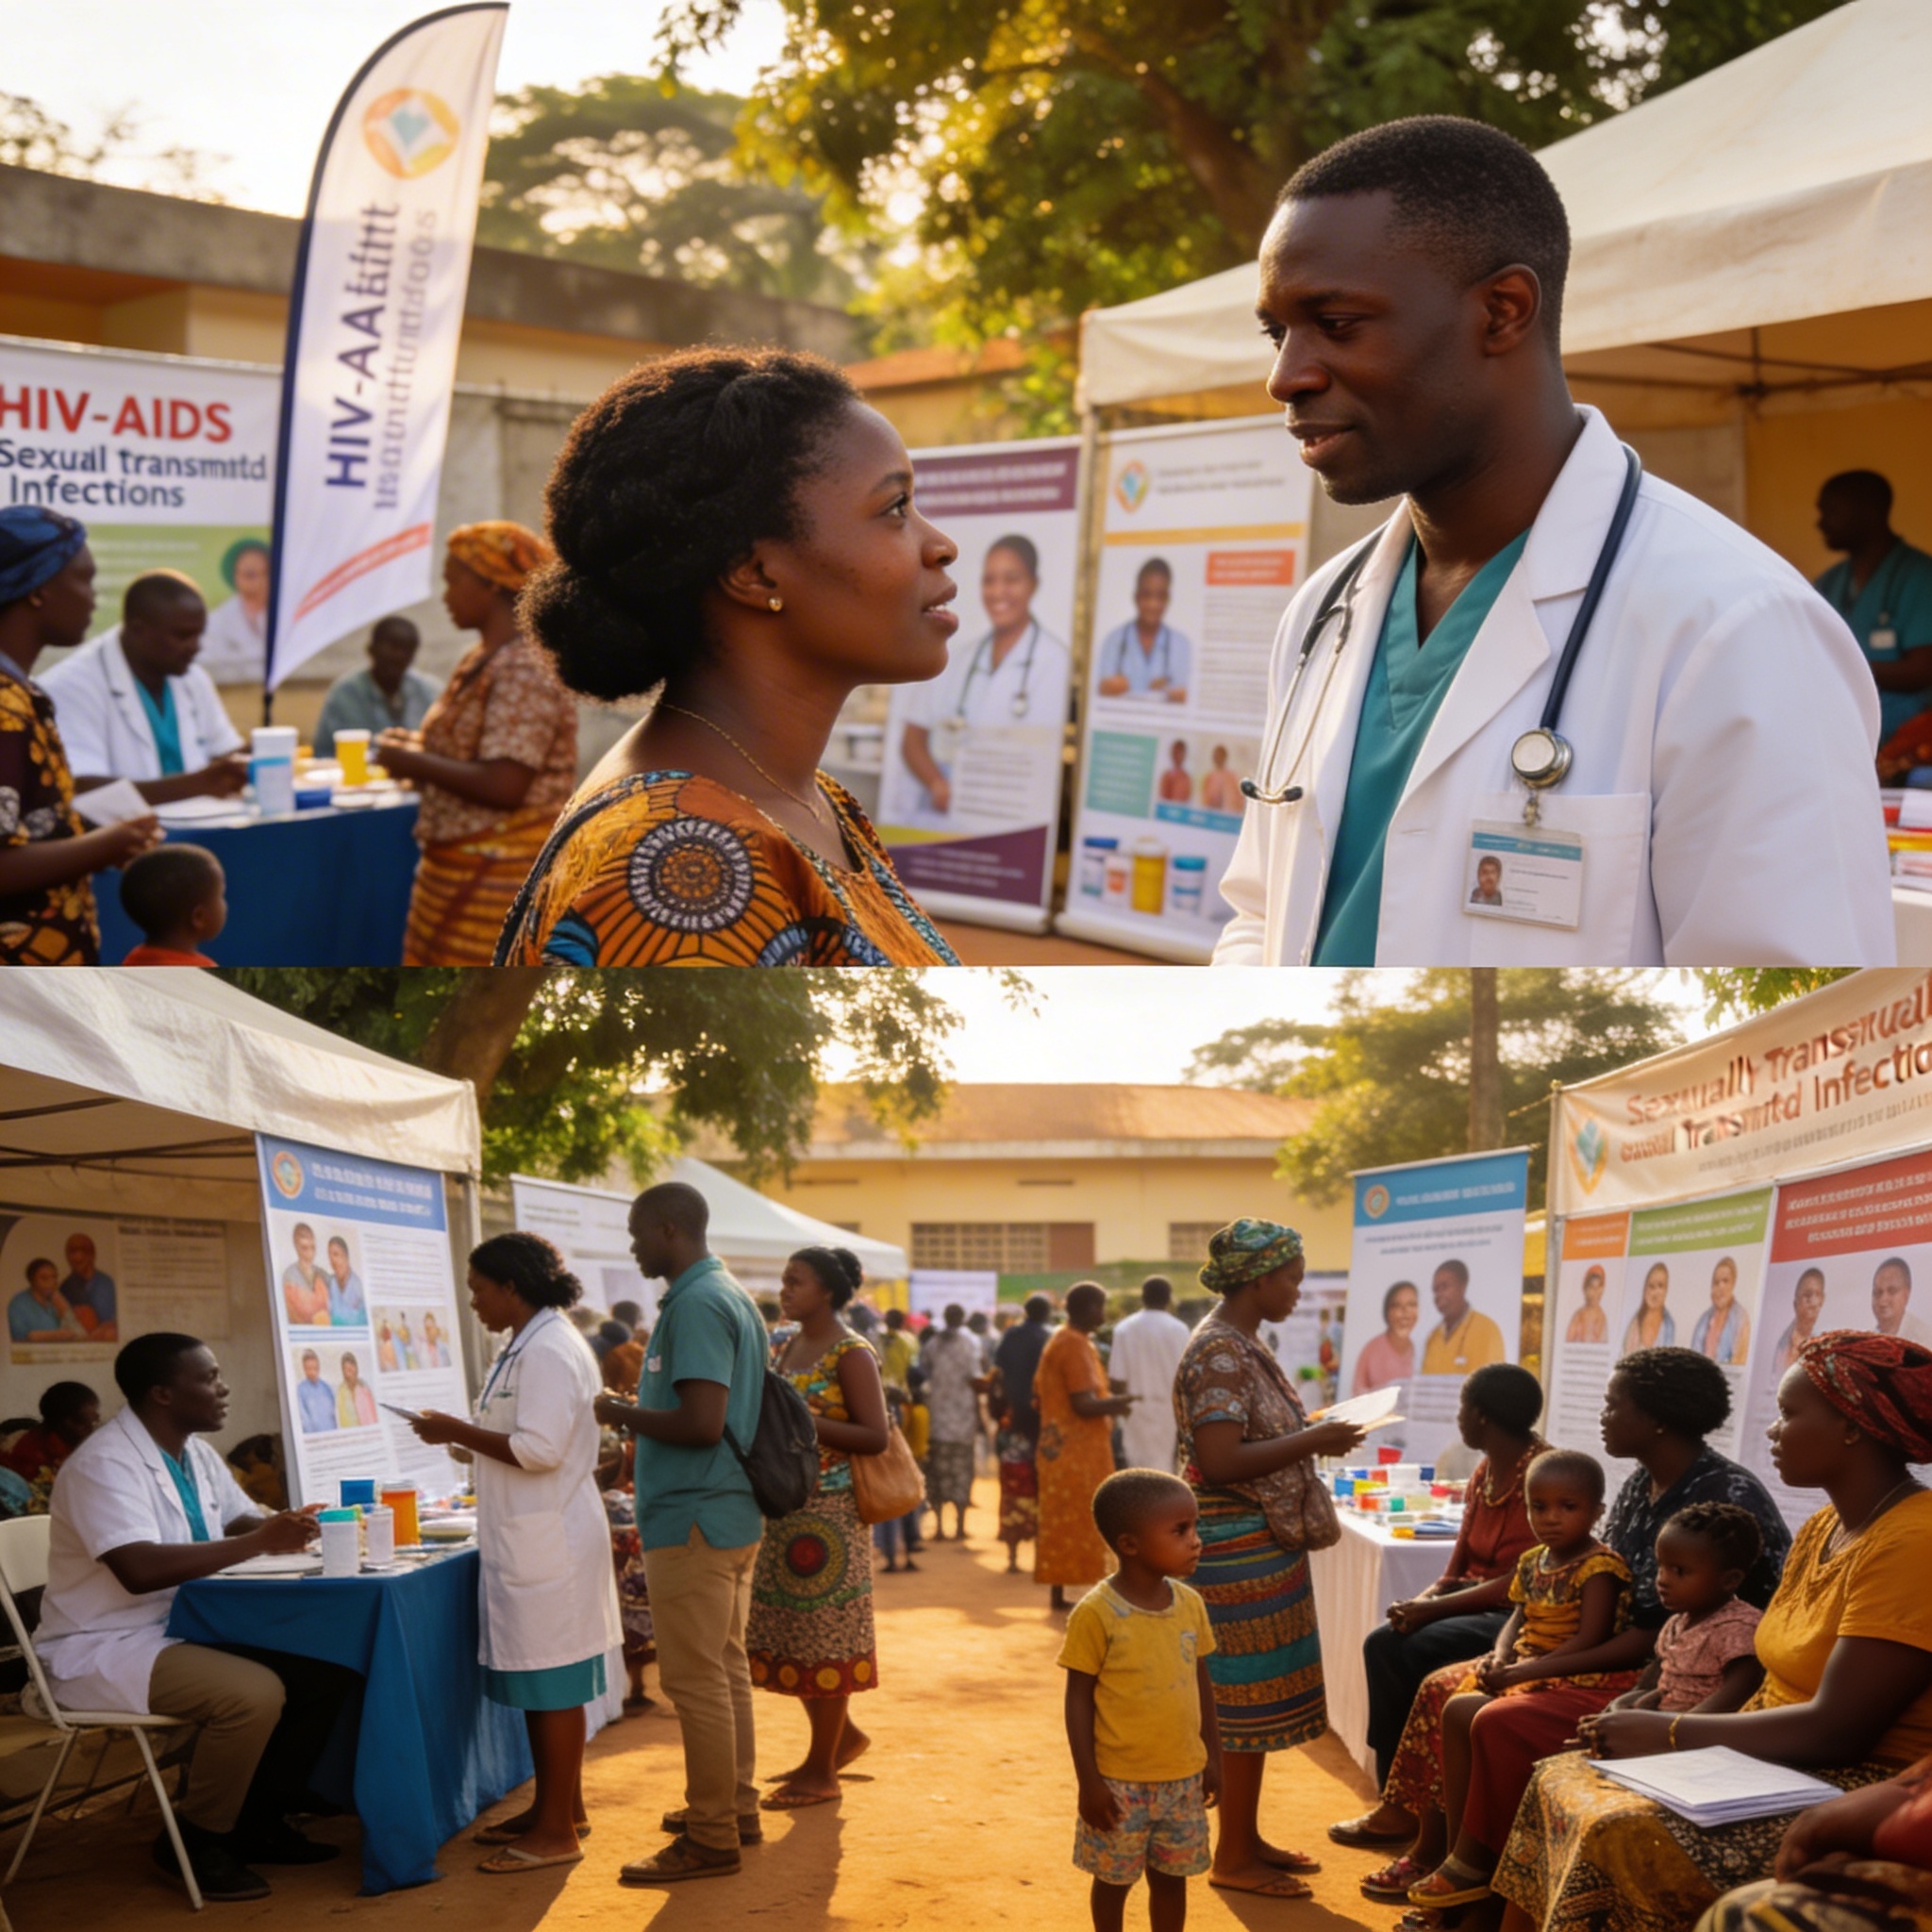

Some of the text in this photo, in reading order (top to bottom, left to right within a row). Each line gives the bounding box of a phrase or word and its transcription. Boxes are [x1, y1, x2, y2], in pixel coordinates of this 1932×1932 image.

[0, 384, 232, 444] HIV-AIDS
[0, 439, 106, 473] Sexual
[10, 474, 185, 508] Infections
